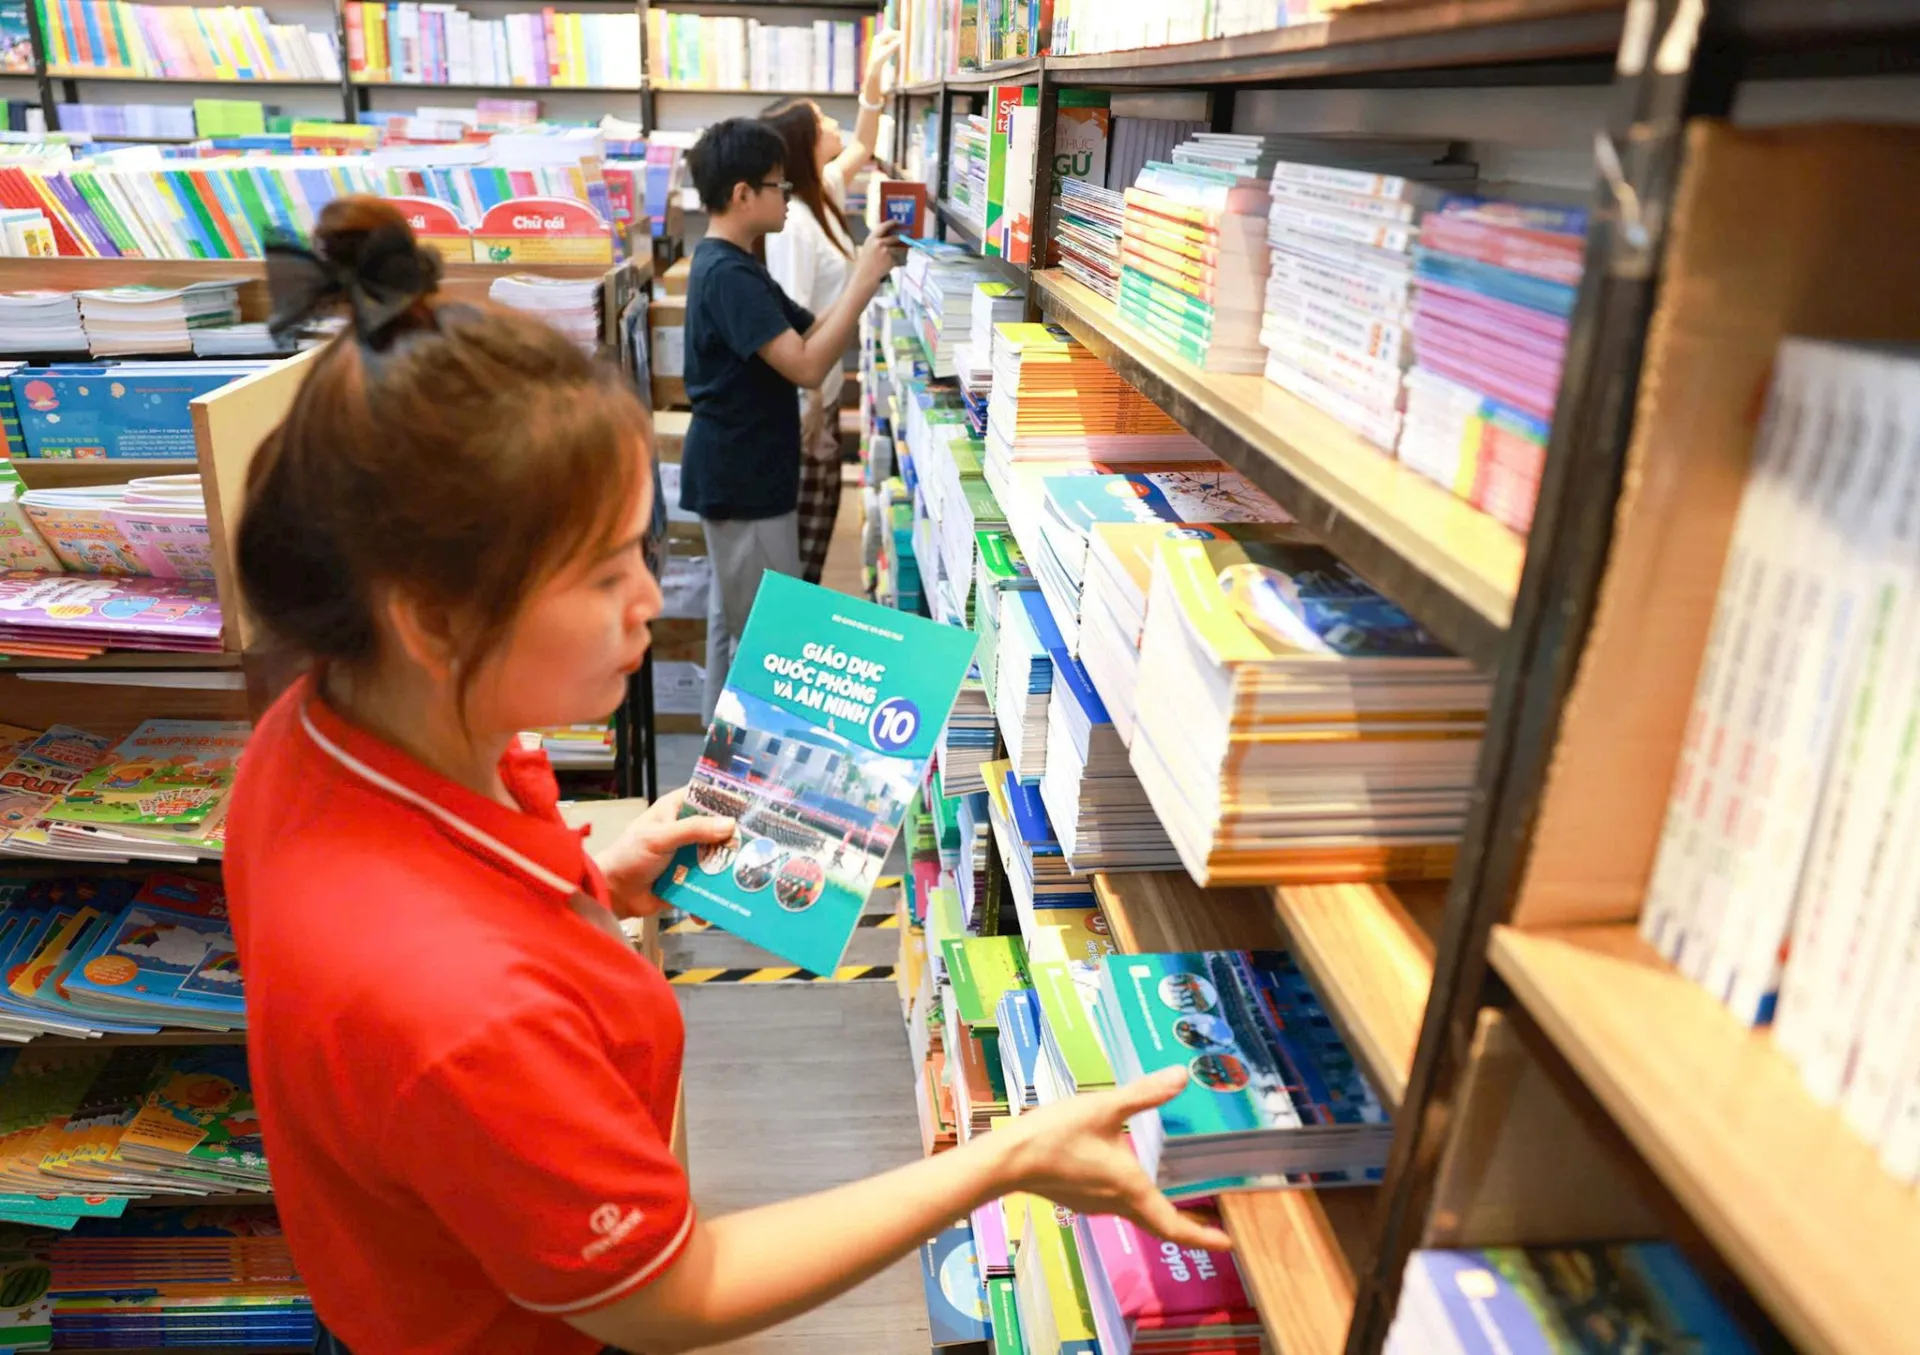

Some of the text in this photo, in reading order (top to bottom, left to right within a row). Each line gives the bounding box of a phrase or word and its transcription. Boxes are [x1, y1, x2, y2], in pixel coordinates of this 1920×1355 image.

[1052, 150, 1093, 177] GỮ
[763, 653, 877, 704] QUỐC PHÒNG
[802, 642, 886, 682] GIÁO DỤC
[773, 679, 871, 725] VÀ AN NINH
[879, 706, 916, 744] 10
[1160, 1241, 1191, 1282] GIÁO
